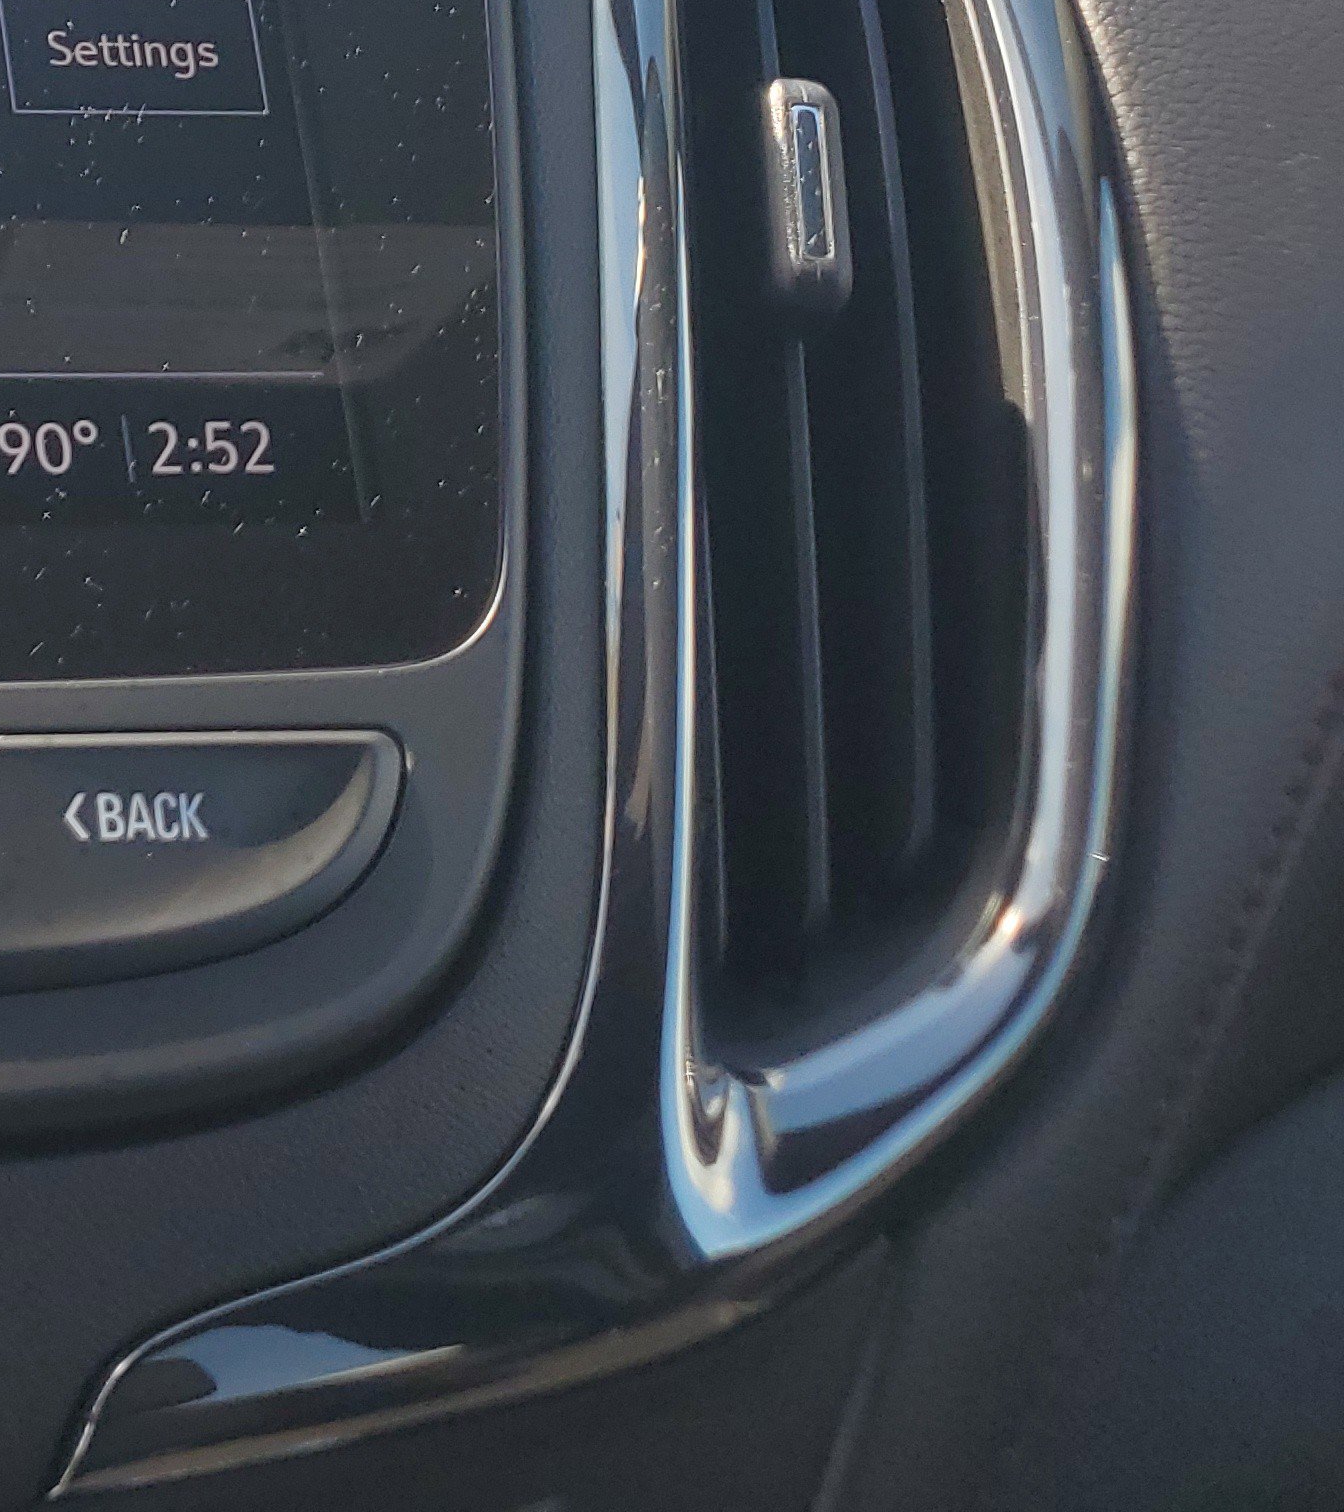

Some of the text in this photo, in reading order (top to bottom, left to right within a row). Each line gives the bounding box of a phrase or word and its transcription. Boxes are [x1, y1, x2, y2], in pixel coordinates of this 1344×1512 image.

[47, 30, 219, 80] Settings
[147, 420, 275, 476] 2:52
[96, 792, 208, 842] BACK
